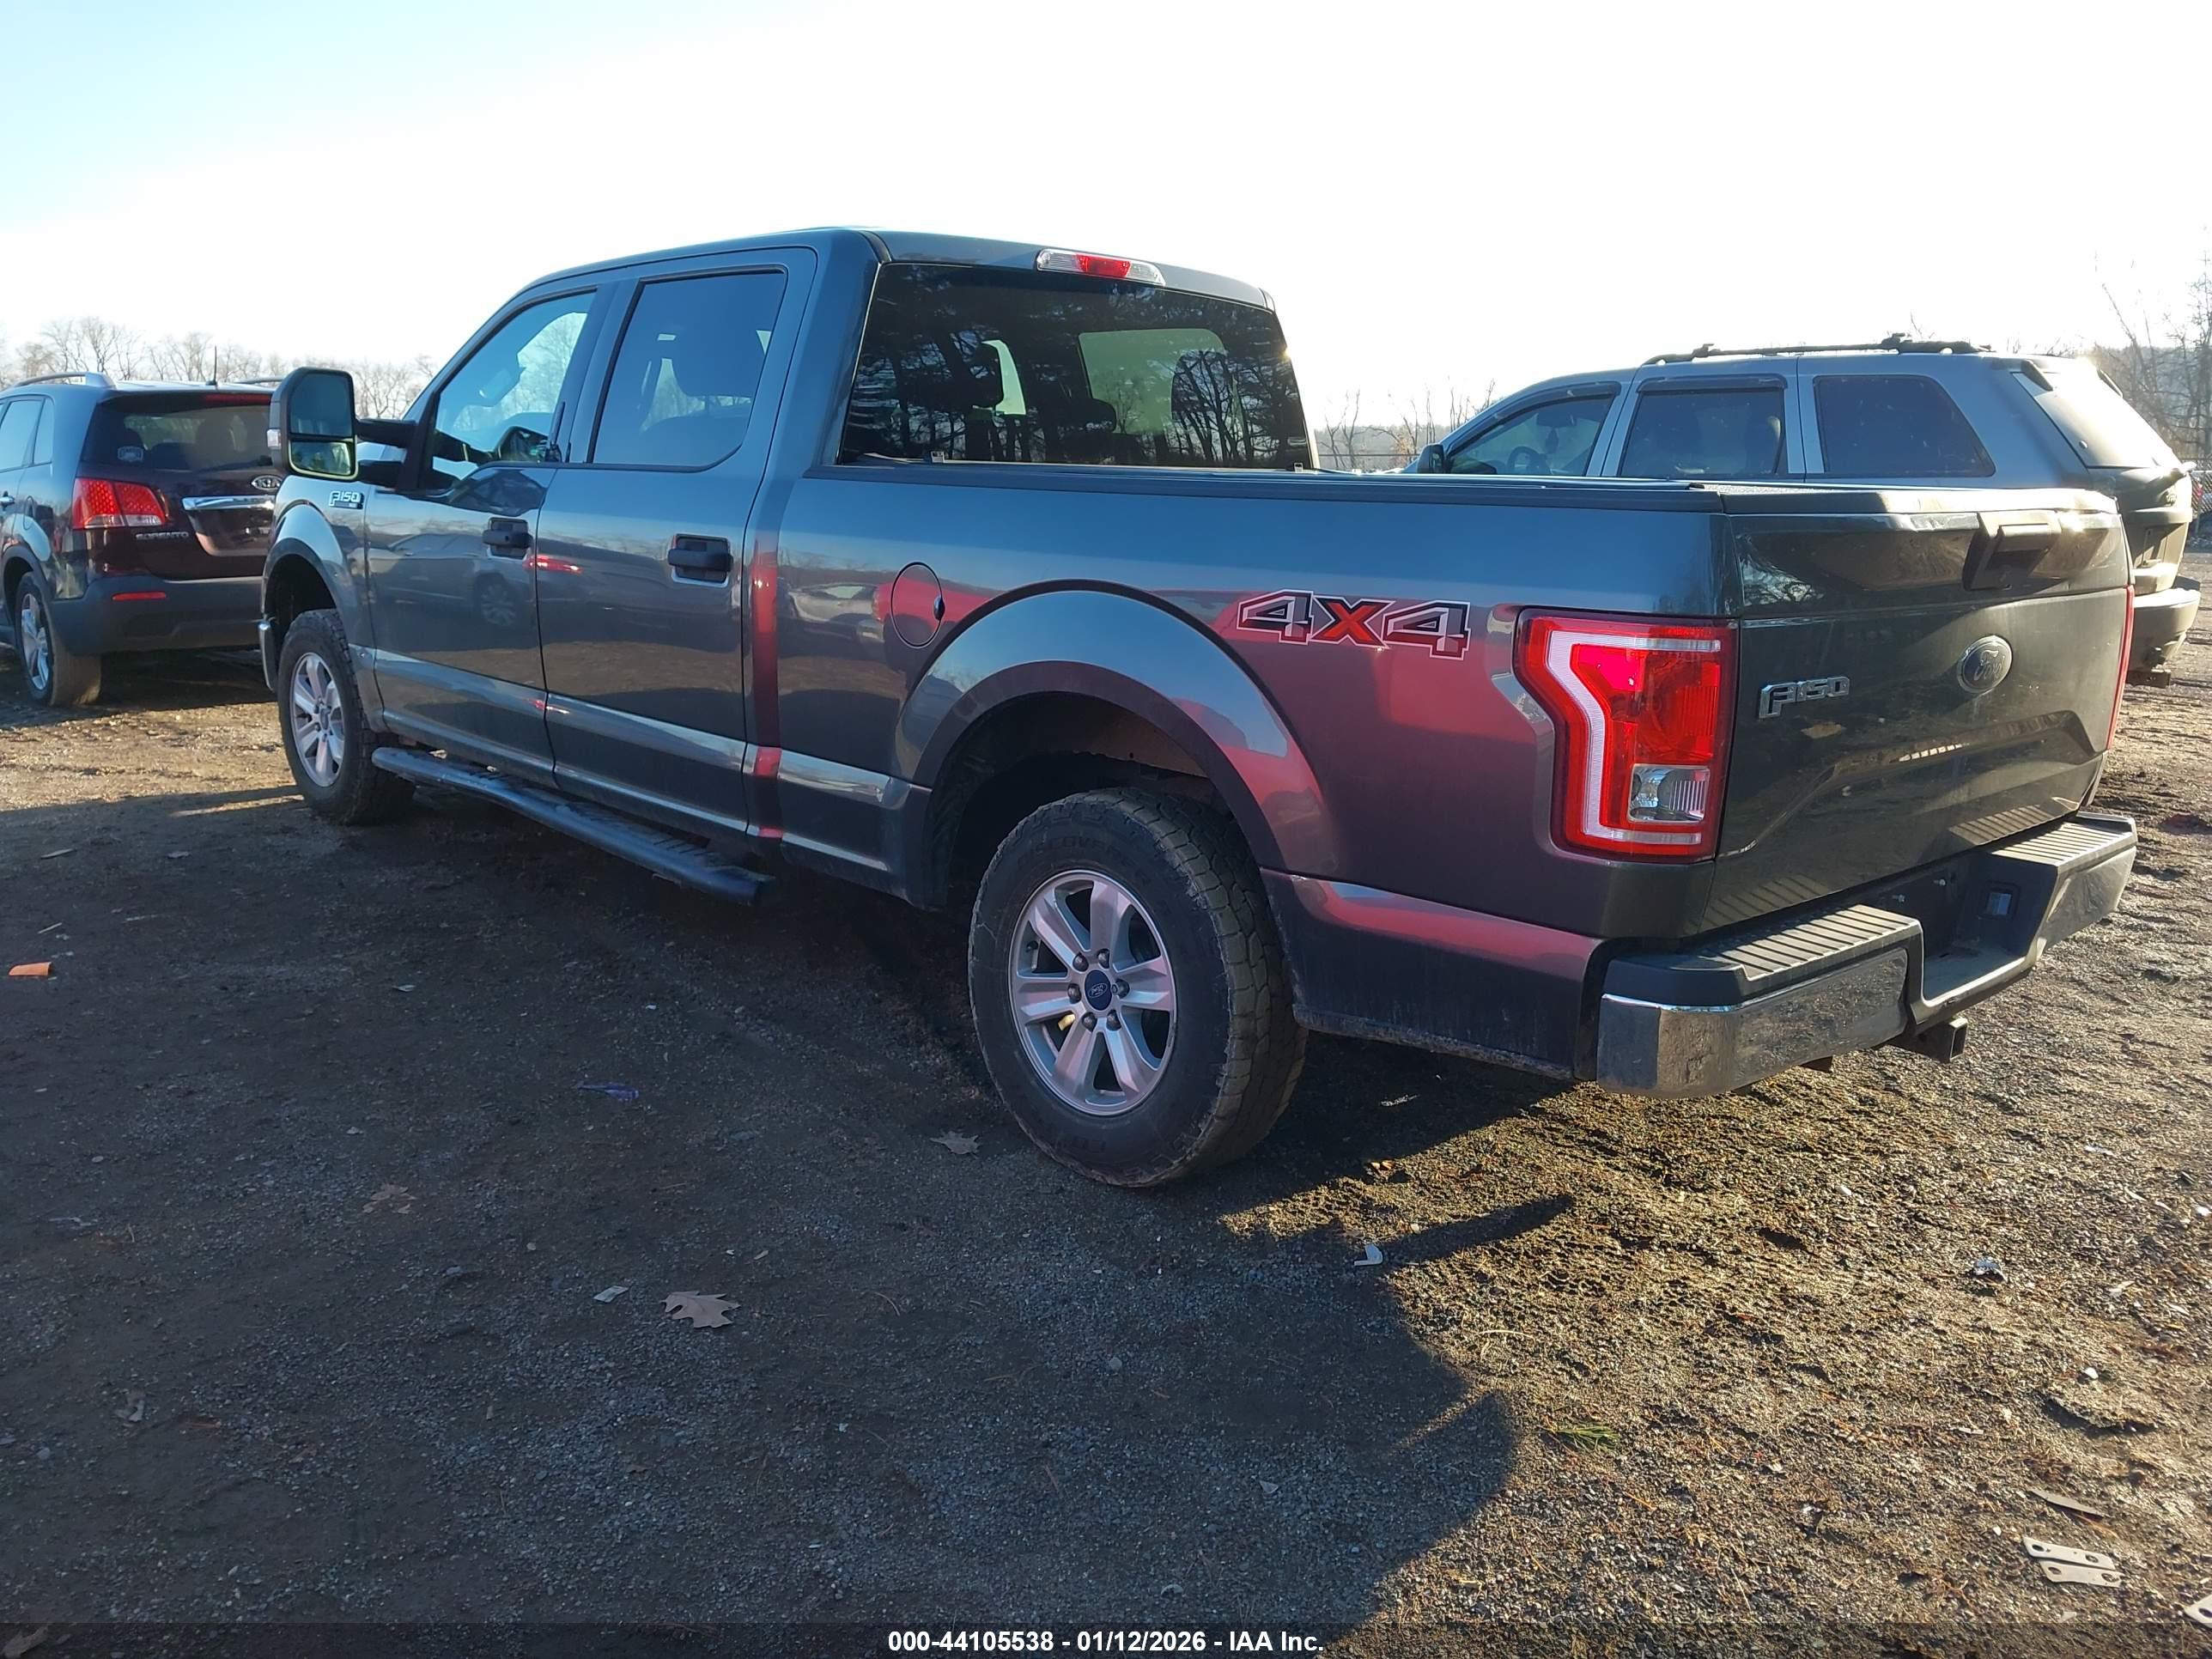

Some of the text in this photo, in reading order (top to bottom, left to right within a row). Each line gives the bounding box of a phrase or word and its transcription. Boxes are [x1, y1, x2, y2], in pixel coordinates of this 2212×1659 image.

[329, 490, 362, 507] F150
[136, 531, 189, 541] SORENTO
[1759, 676, 1850, 719] F150
